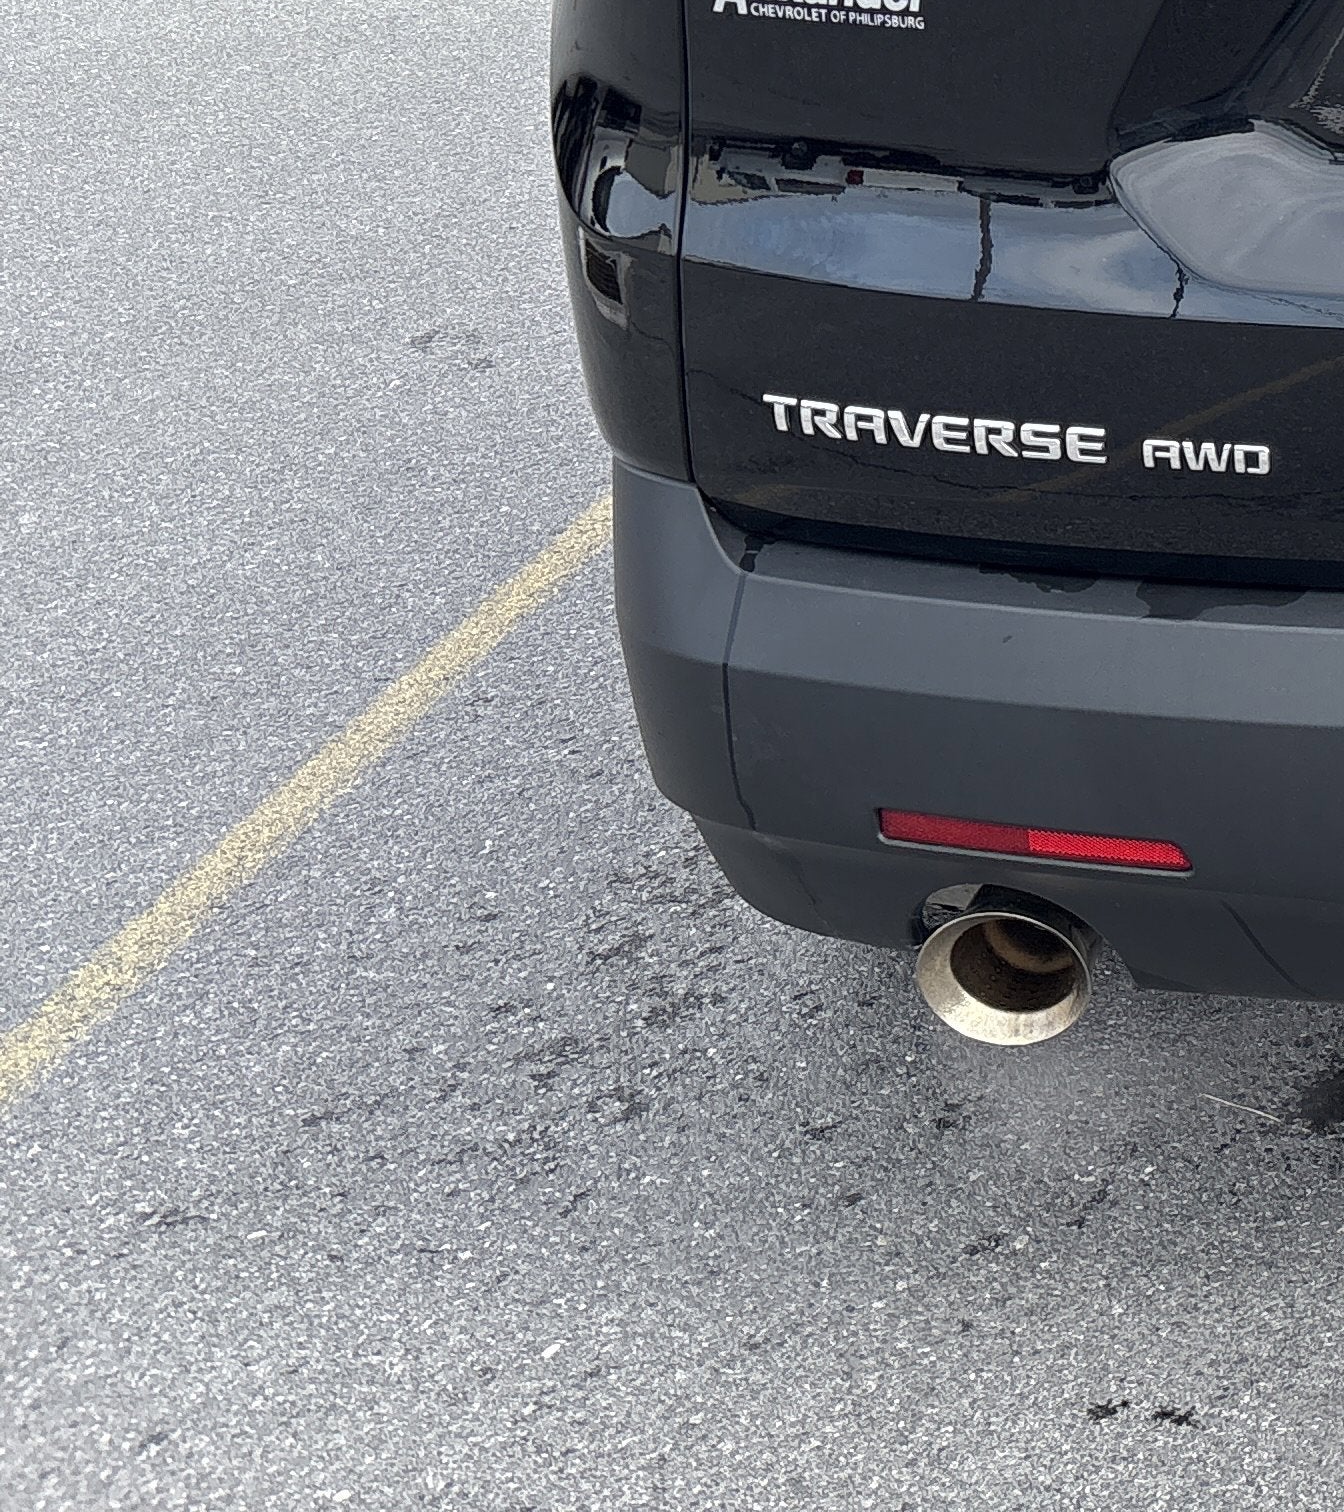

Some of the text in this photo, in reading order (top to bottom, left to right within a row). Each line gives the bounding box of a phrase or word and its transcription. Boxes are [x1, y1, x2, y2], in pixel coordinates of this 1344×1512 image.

[750, 2, 925, 30] CHEVROLET OF PHILIPSBURG
[762, 393, 1271, 476] TRAVERSE AWD
